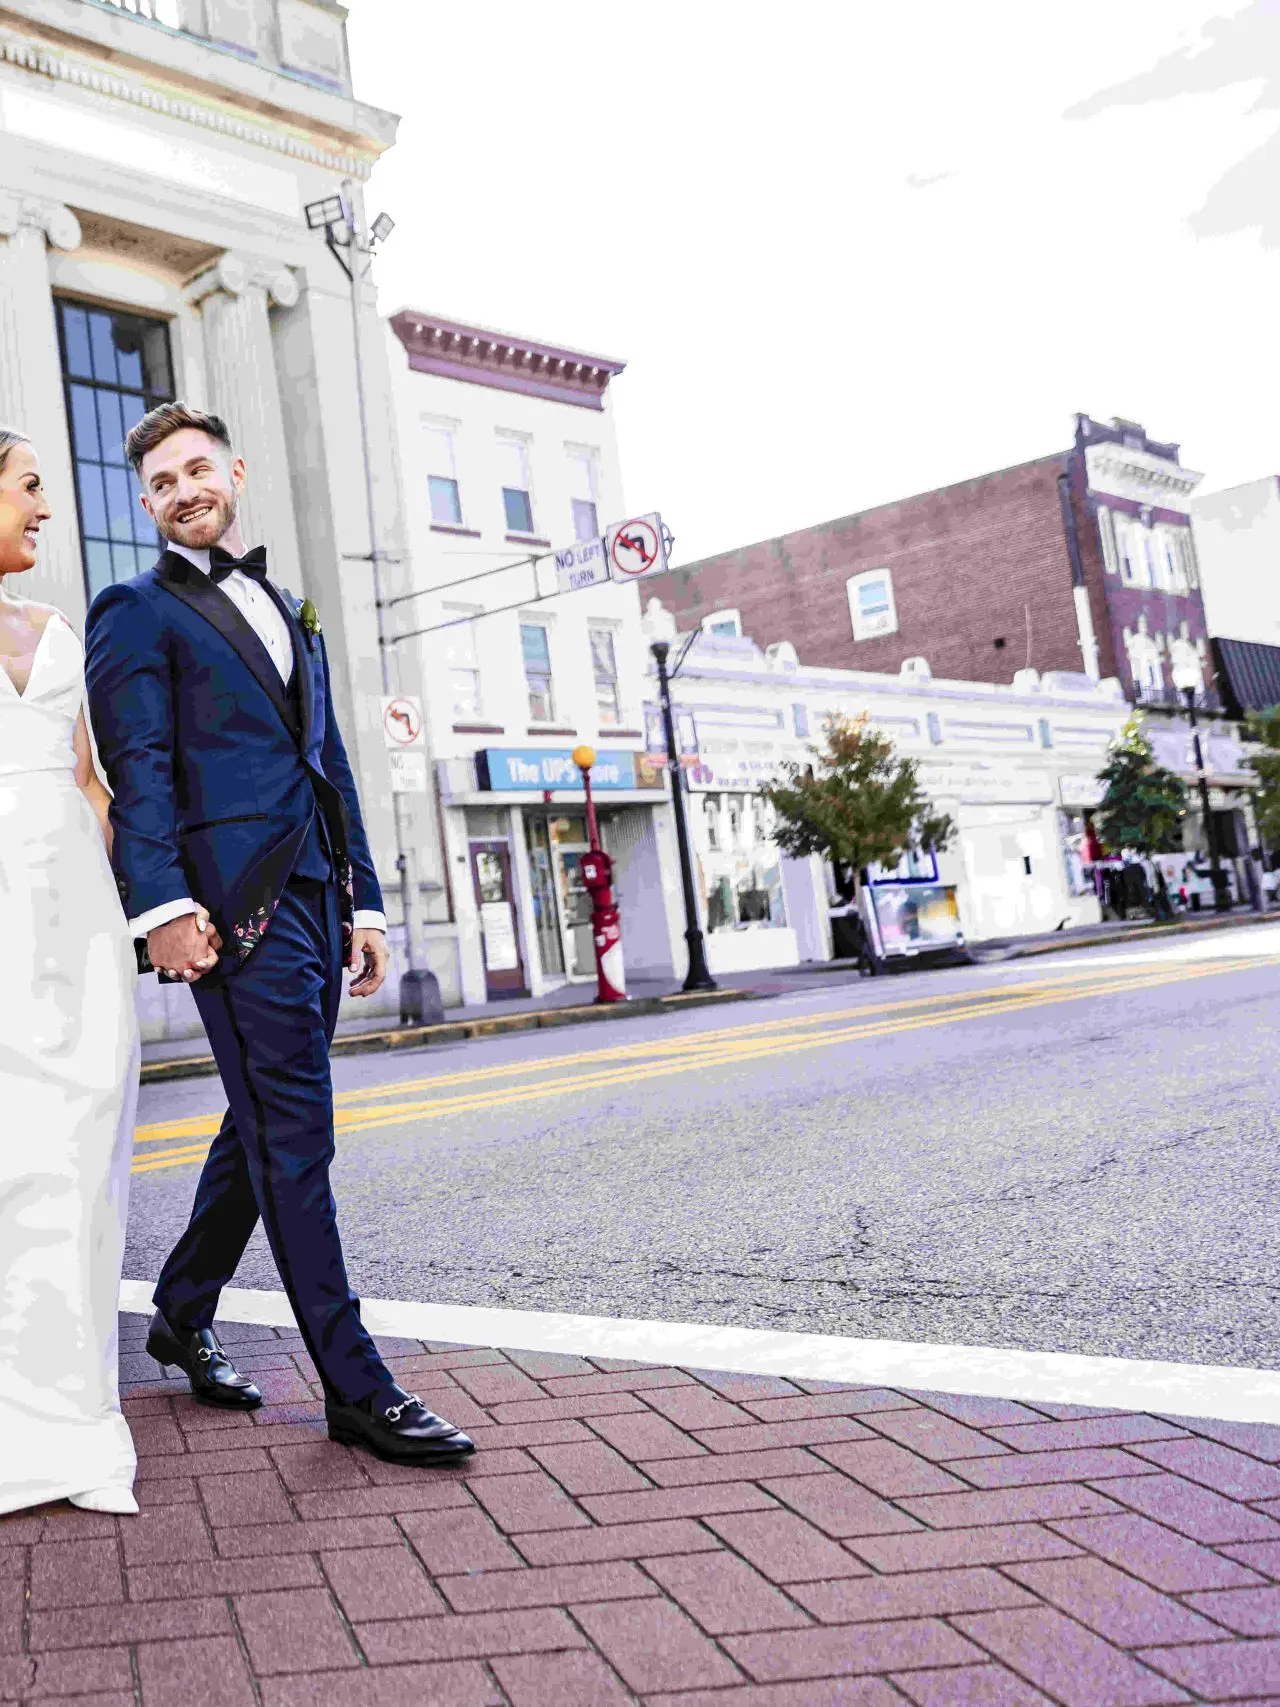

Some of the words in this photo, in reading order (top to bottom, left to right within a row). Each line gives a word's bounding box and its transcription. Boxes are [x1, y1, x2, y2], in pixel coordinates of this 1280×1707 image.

[555, 550, 574, 571] NO
[576, 544, 600, 564] LEFT
[568, 569, 594, 588] TURN
[506, 757, 539, 783] The
[542, 757, 577, 783] UPS
